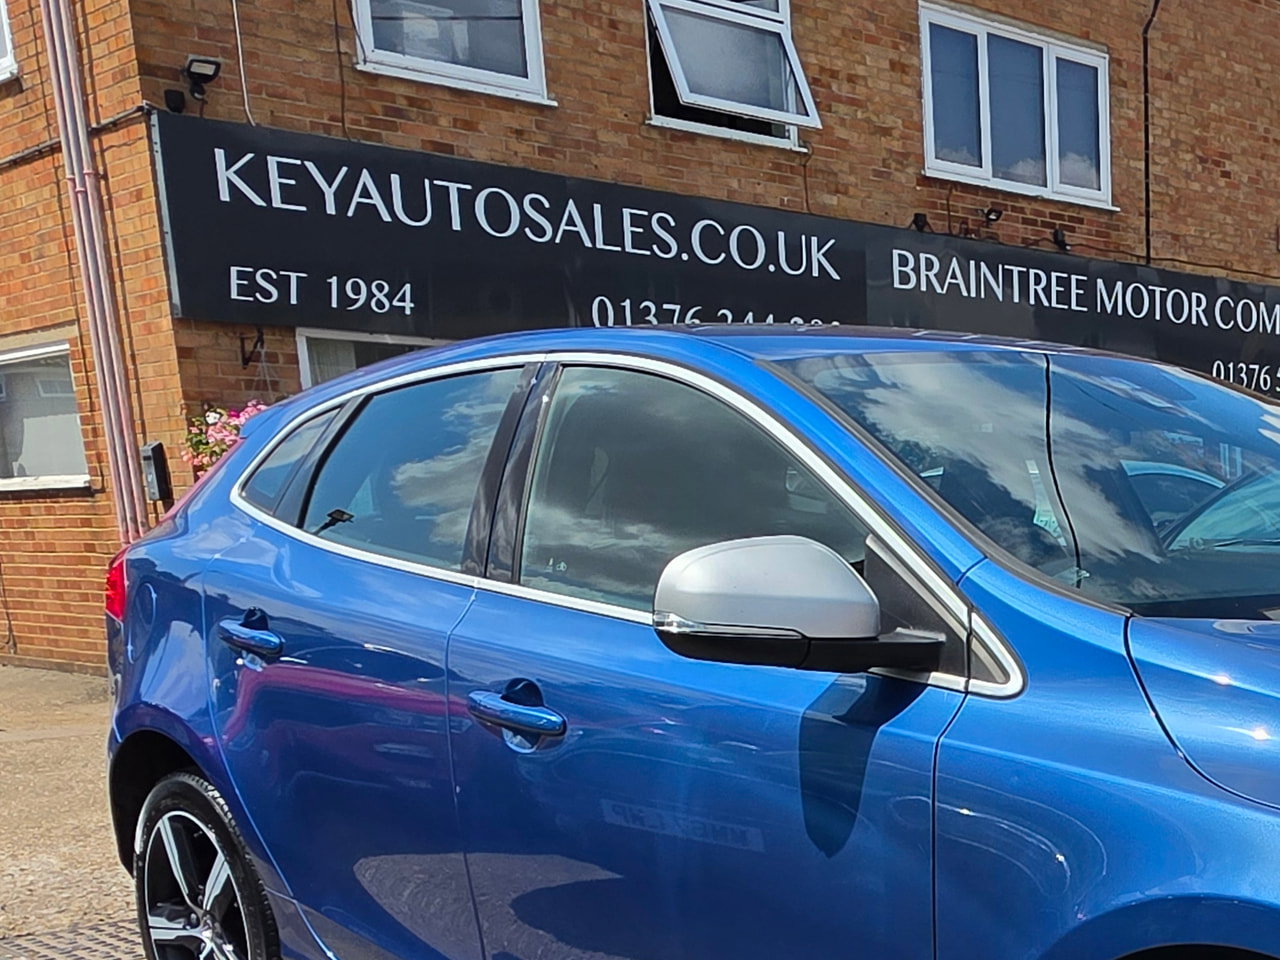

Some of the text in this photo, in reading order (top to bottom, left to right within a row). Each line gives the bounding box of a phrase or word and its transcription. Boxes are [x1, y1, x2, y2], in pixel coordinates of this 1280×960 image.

[213, 147, 841, 281] KEYAUTOSALES.CO.UK
[229, 265, 415, 316] EST 1984
[891, 248, 1088, 312] BRAINTREE
[1095, 278, 1209, 327] MOTOR
[1212, 360, 1271, 391] 01376
